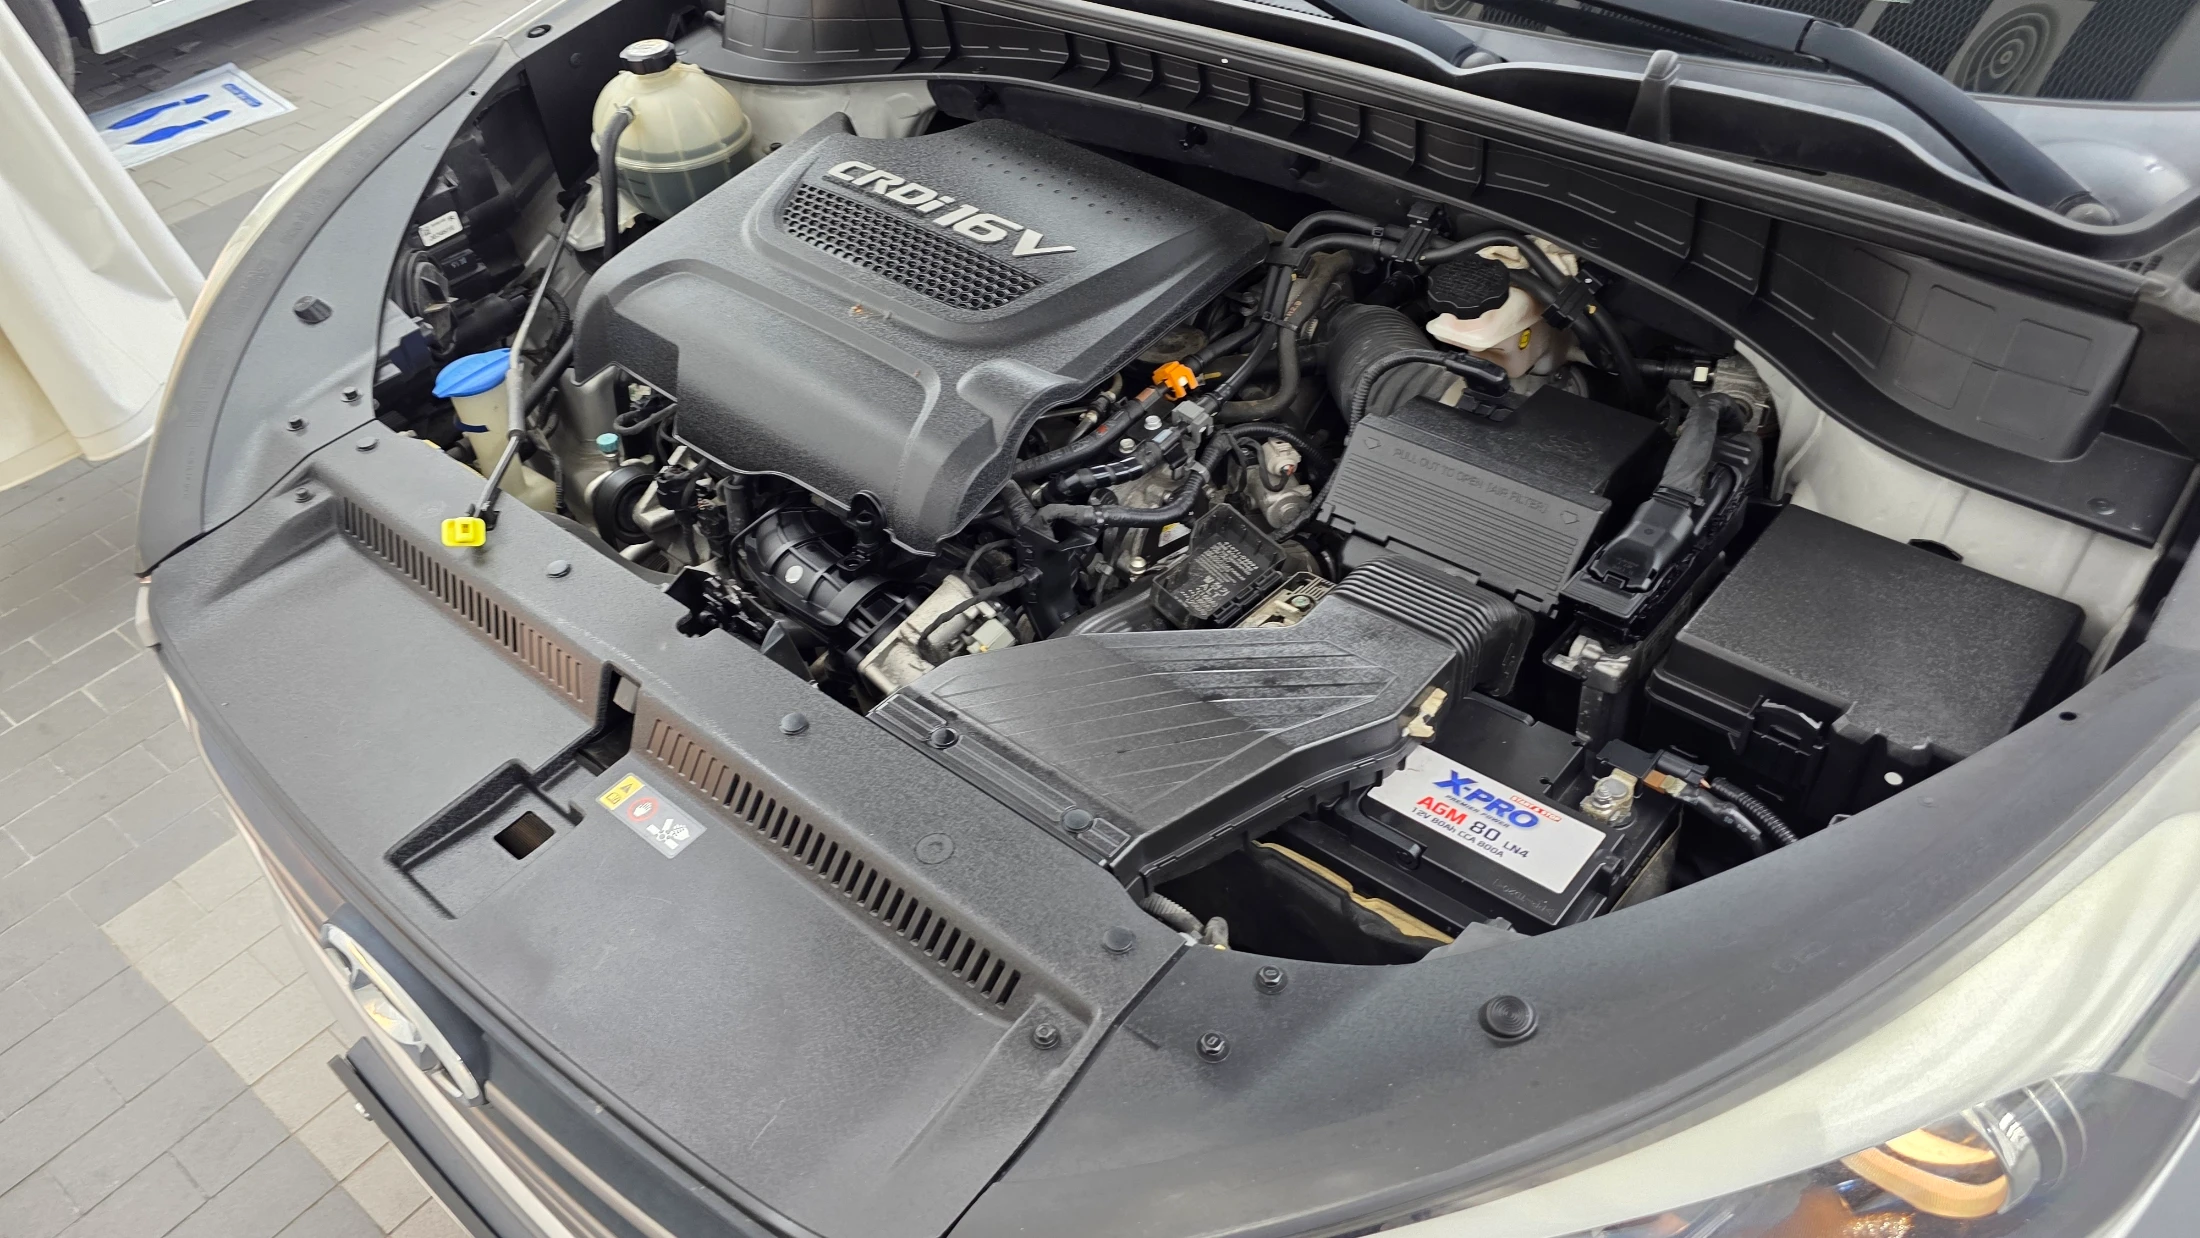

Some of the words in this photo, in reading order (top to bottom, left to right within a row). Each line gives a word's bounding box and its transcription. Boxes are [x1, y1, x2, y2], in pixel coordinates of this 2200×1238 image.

[1392, 448, 1417, 465] PULL
[1419, 457, 1439, 472] OUT
[1441, 464, 1456, 478] TO
[1456, 470, 1484, 490] OPEN
[1432, 769, 1539, 829] X-PRO
[1444, 794, 1479, 813] PREMIER
[1480, 812, 1511, 828] POWER
[1411, 807, 1431, 819] 12V
[1430, 817, 1457, 834] 80Ah
[1457, 830, 1477, 844] CCA
[1477, 839, 1504, 858] 800A
[1416, 795, 1468, 825] AGM
[1469, 820, 1502, 843] 80
[1502, 840, 1530, 859] LN4
